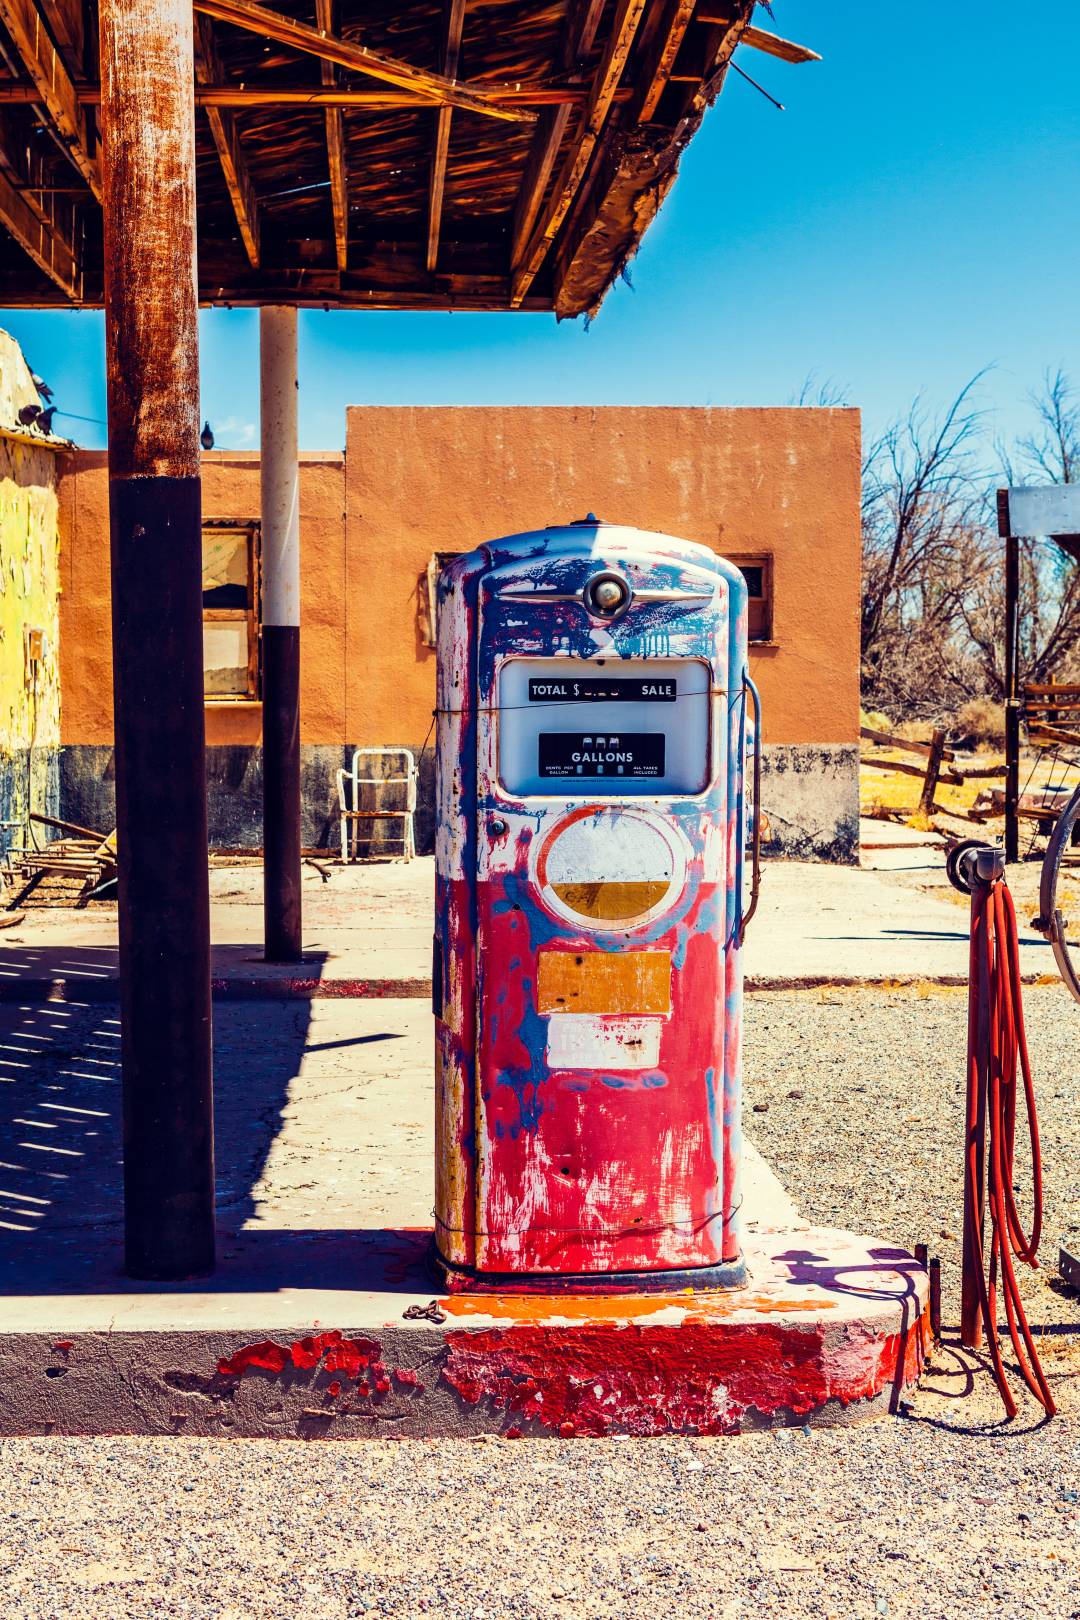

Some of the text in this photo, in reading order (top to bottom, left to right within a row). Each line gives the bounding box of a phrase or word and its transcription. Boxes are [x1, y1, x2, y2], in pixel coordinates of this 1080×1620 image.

[532, 685, 567, 695] TOTAL
[573, 683, 580, 697] $
[641, 685, 672, 695] SALE
[571, 752, 633, 763] GALLONS
